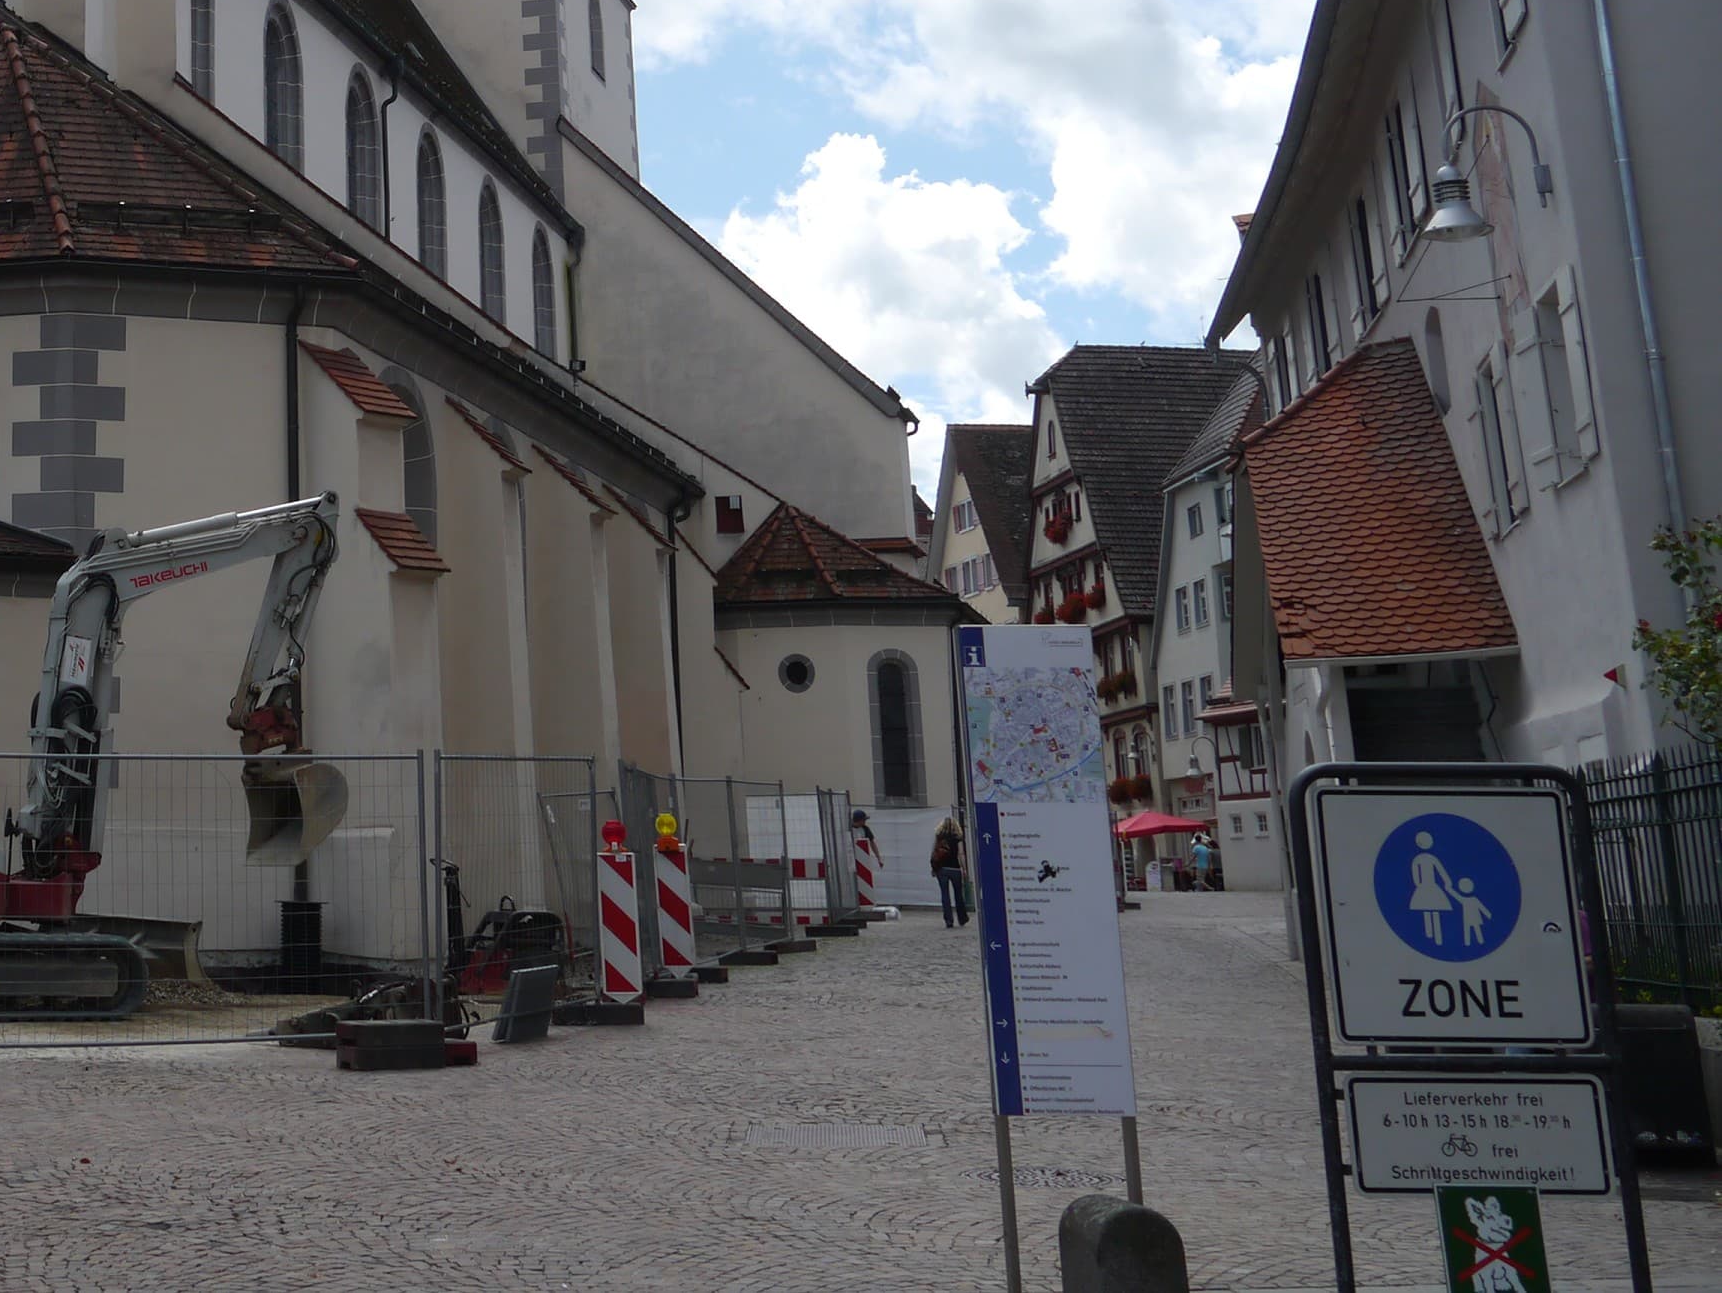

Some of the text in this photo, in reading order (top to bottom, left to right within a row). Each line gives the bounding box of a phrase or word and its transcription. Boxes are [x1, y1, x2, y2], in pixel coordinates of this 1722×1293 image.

[129, 561, 208, 588] TAKEUCHI
[1398, 978, 1524, 1018] ZONE
[1403, 1091, 1544, 1108] Lieferverkehr frei
[1492, 1144, 1518, 1158] frei
[1392, 1165, 1575, 1184] Schrittgeschwindigkeit!
